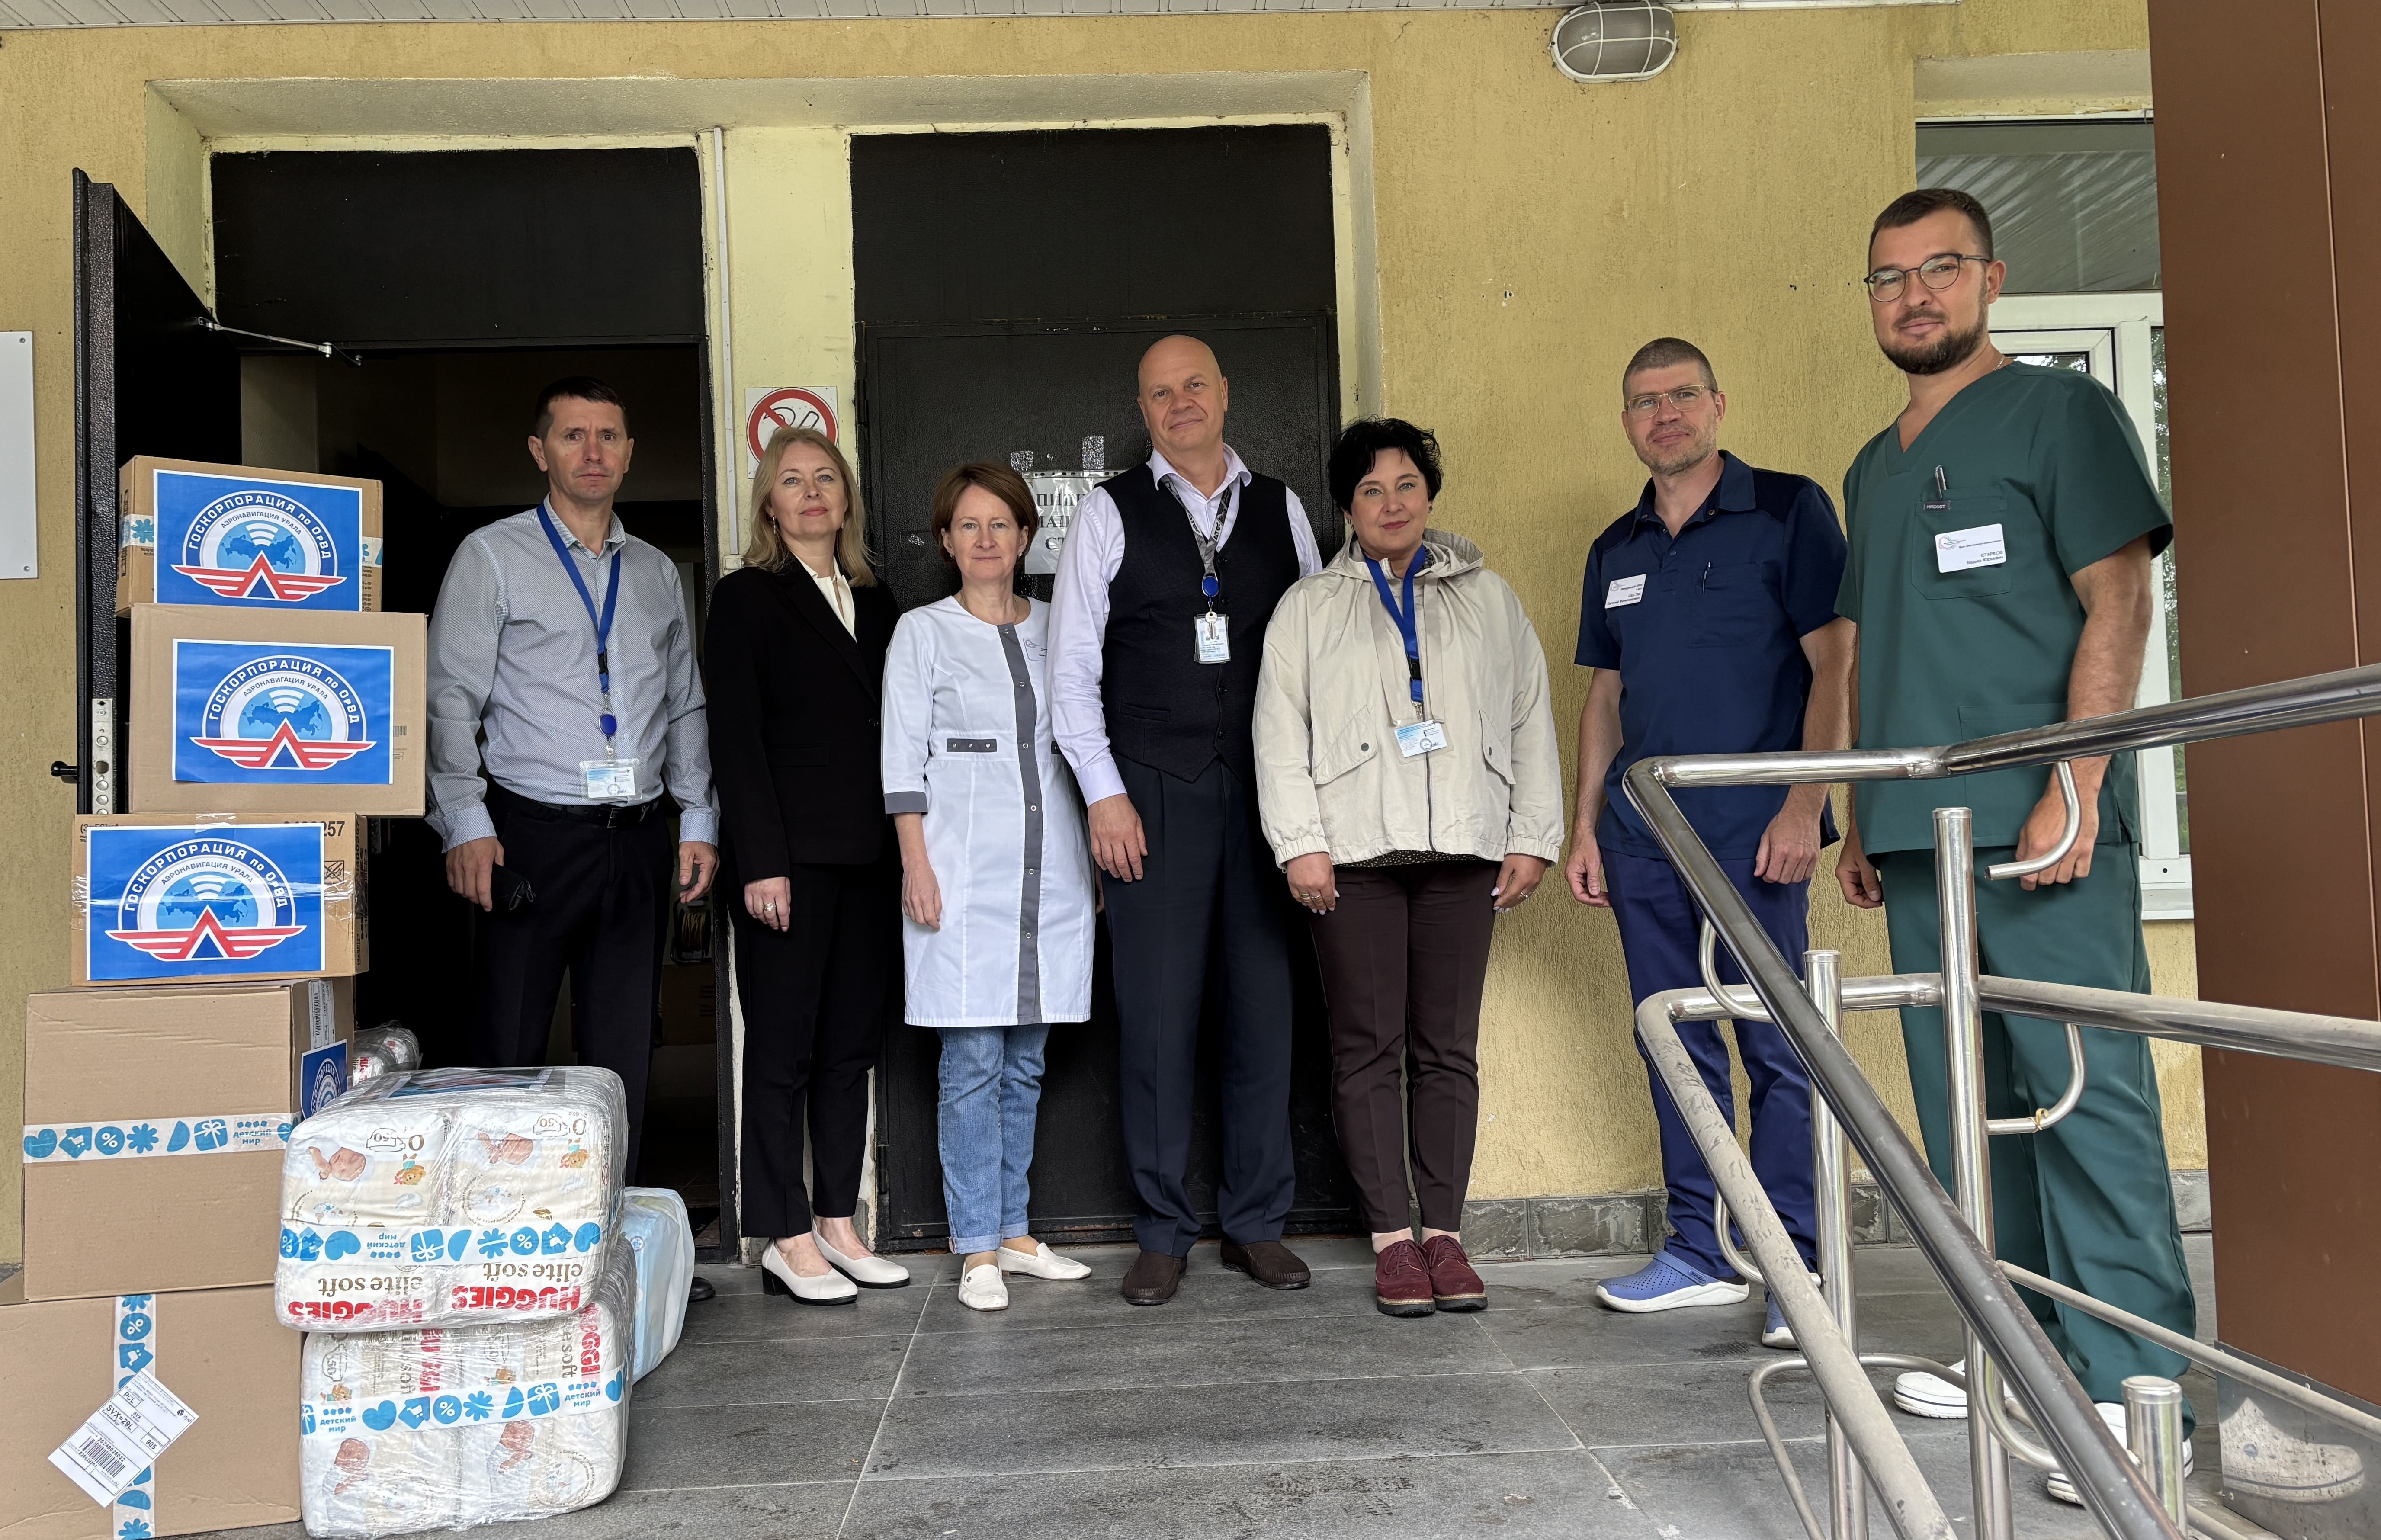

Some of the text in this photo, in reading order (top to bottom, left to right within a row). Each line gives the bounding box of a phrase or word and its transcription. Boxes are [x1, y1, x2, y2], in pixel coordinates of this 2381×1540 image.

[189, 495, 295, 550] ГОСКОРПОРАЦИЯ
[298, 513, 311, 525] по
[221, 511, 302, 535] АЭРОНАВИГАЦИЯ УРАЛА
[209, 660, 323, 720] ГОСКОРПОРАЦИЯ
[324, 676, 339, 689] по
[243, 677, 328, 699] АЭРОНАВИГАЦИЯ УРАЛА
[125, 844, 247, 911] ГОСКОРПОРАЦИЯ
[250, 858, 265, 871] по
[161, 861, 254, 885] АЭРОНАВИГАЦИЯ УРАЛА
[233, 1129, 272, 1138] детский
[367, 1241, 406, 1249] детский
[533, 1264, 583, 1283] elite
[318, 1277, 366, 1297] soft
[452, 1285, 581, 1311] HUGGIES
[123, 1392, 135, 1404] PCL
[565, 1389, 601, 1401] детский
[320, 1415, 356, 1425] детский
